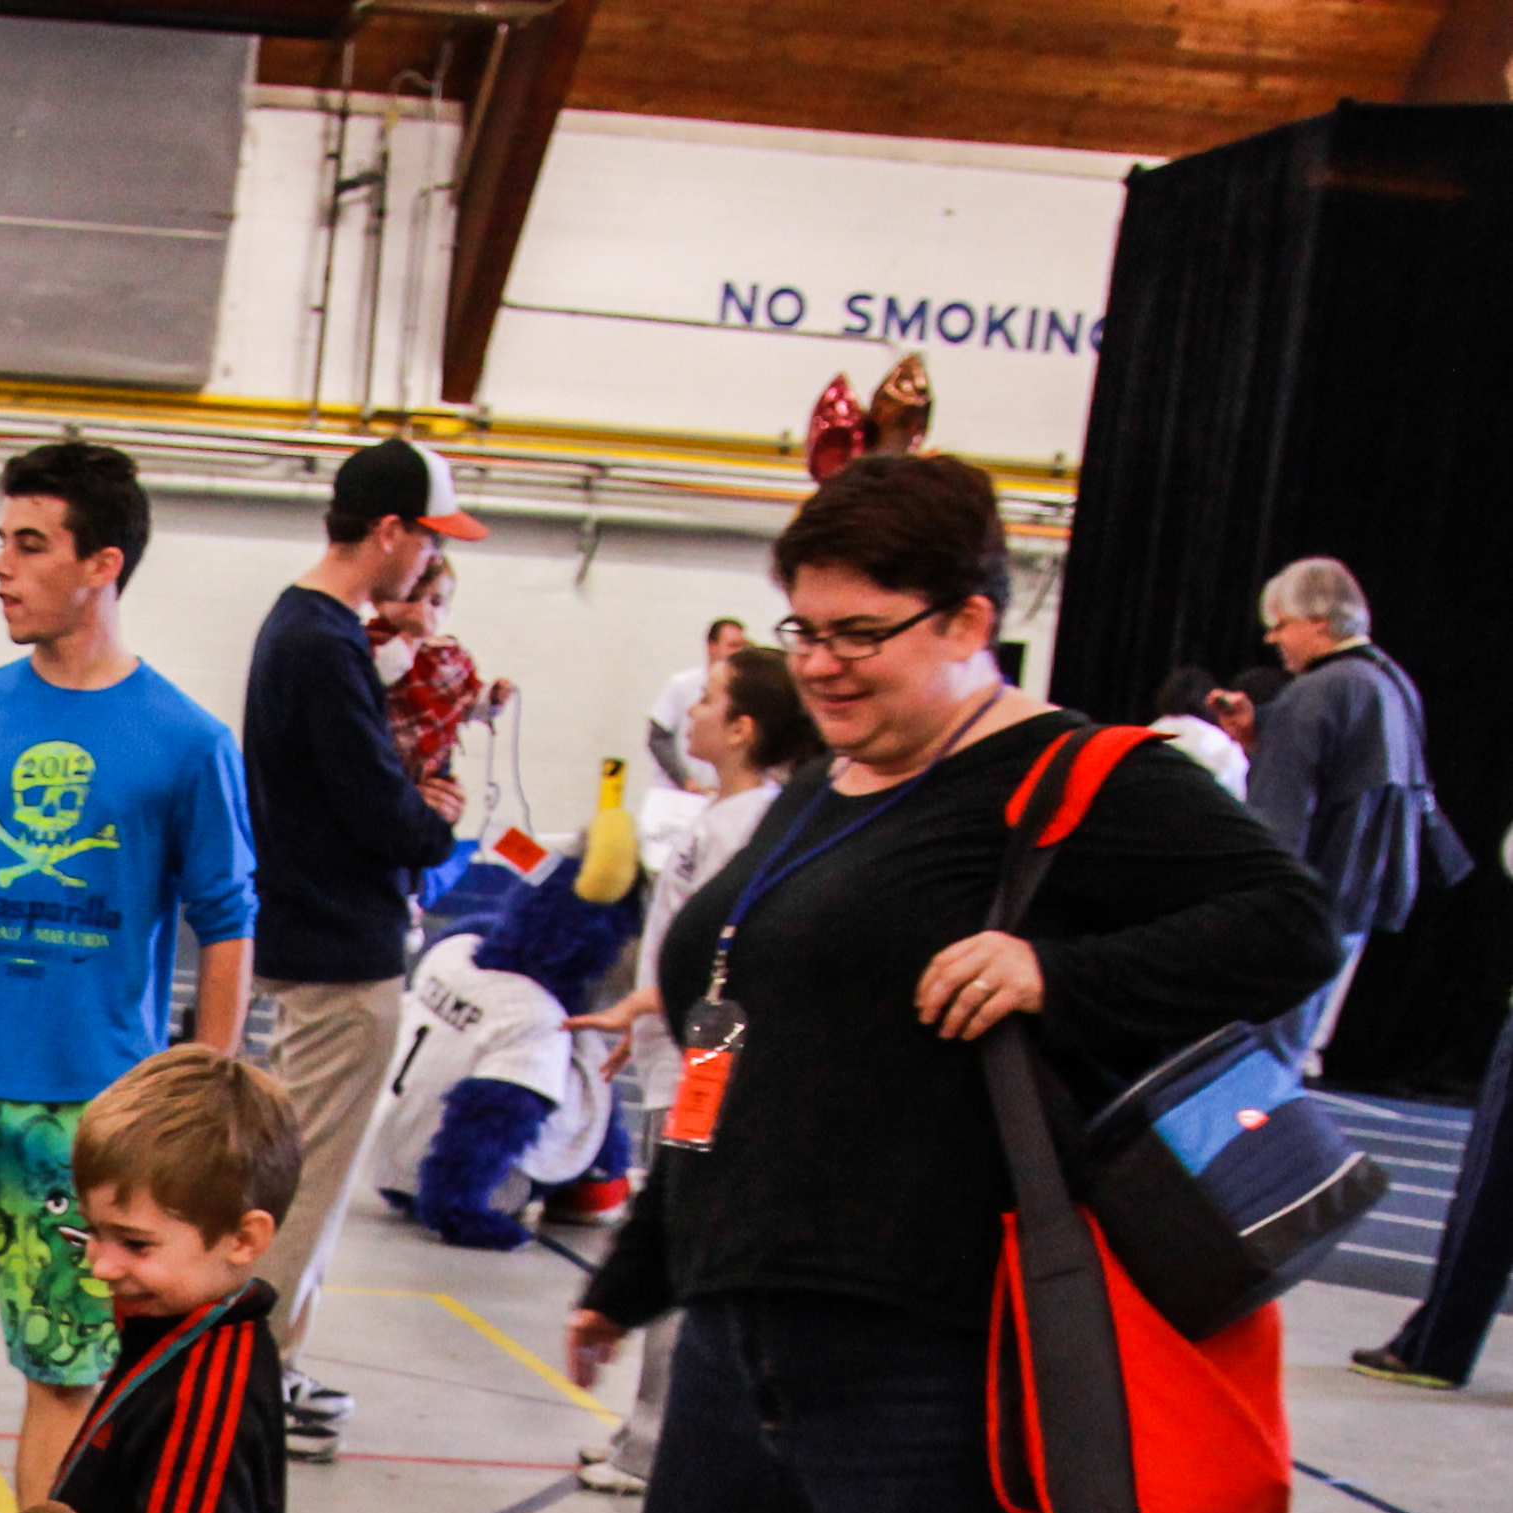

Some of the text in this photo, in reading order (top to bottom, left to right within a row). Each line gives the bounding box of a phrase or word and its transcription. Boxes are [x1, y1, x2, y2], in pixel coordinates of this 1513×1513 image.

[719, 281, 805, 328] NO
[22, 757, 91, 779] 2012
[393, 1024, 430, 1096] 1
